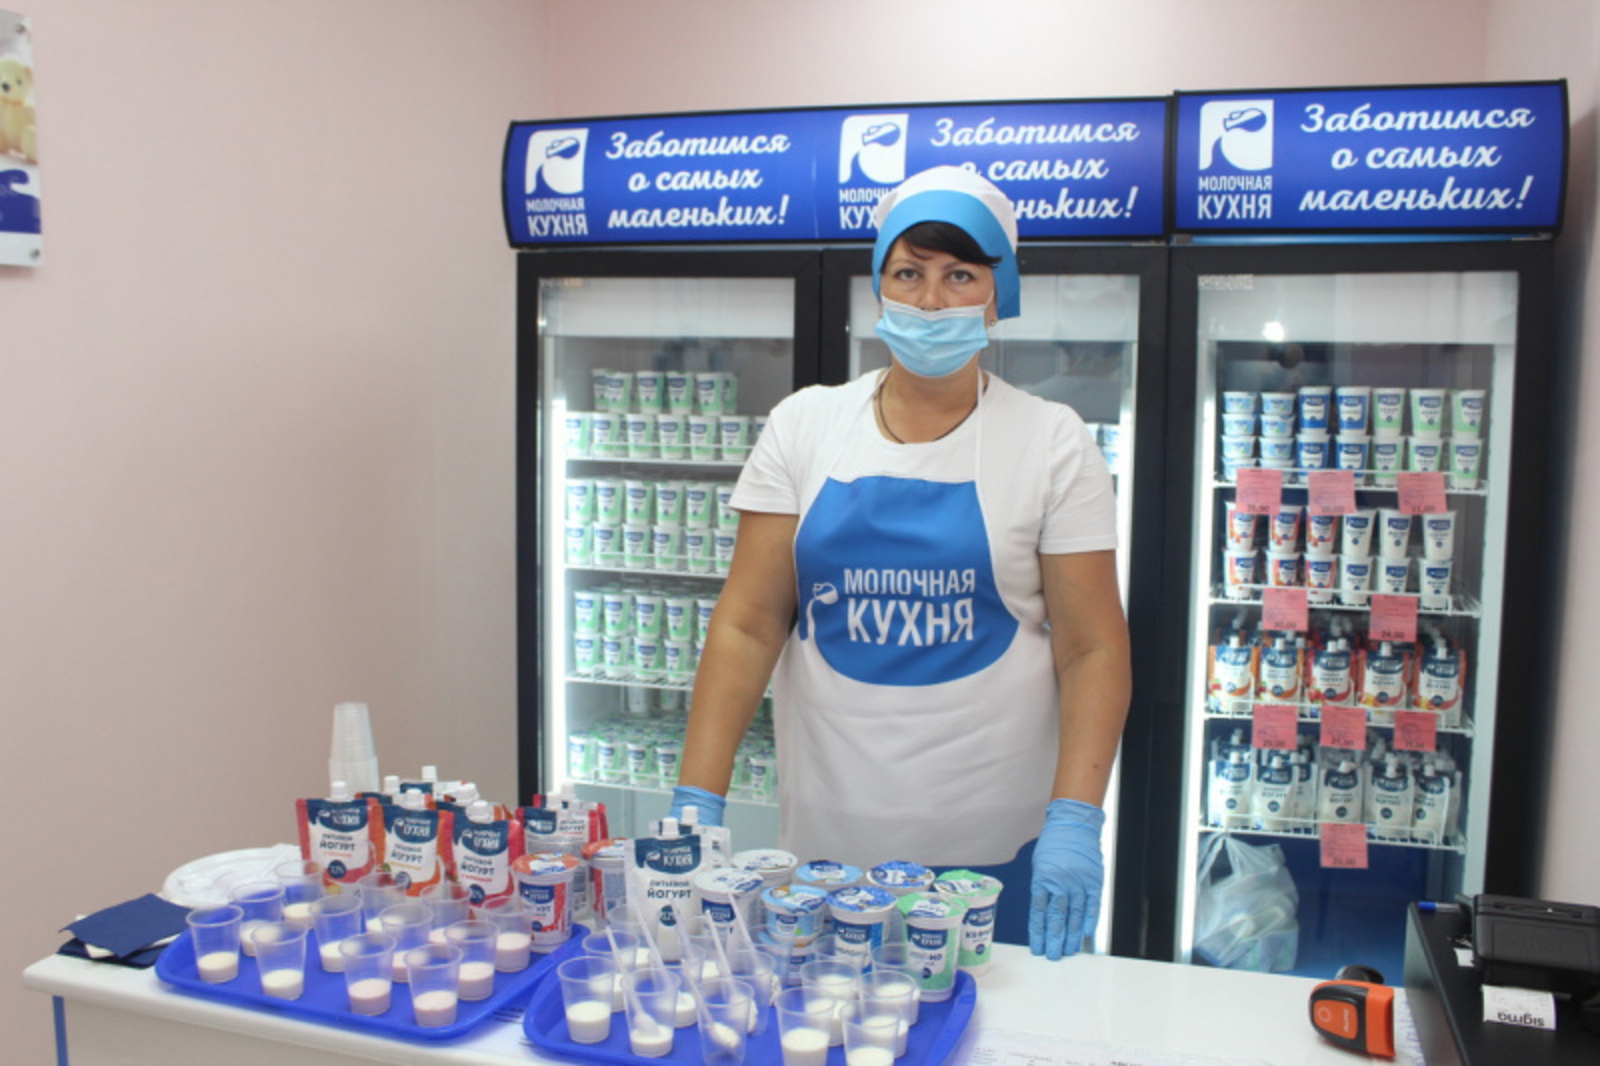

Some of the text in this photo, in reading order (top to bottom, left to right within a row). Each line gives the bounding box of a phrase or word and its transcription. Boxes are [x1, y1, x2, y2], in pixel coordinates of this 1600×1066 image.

[930, 116, 1140, 147] Заботимся
[1300, 102, 1536, 134] Заботимся
[604, 130, 791, 159] Заботимся
[1330, 143, 1502, 170] о самых
[628, 167, 764, 192] о самых
[987, 157, 1109, 180] самых
[1198, 175, 1273, 191] МОЛОЧНАЯ
[1298, 174, 1535, 213] маленьких!
[526, 197, 585, 212] МОЛОЧНАЯ
[608, 193, 791, 229] маленьких!
[1014, 185, 1139, 219] ньких!
[1197, 193, 1273, 221] КУХНЯ
[527, 213, 589, 237] КУХНЯ
[843, 568, 976, 597] МОЛОЧНАЯ
[847, 597, 975, 647] КУХНЯ
[647, 888, 692, 899] ЙОГУРТ
[1496, 1011, 1545, 1027] sigma
